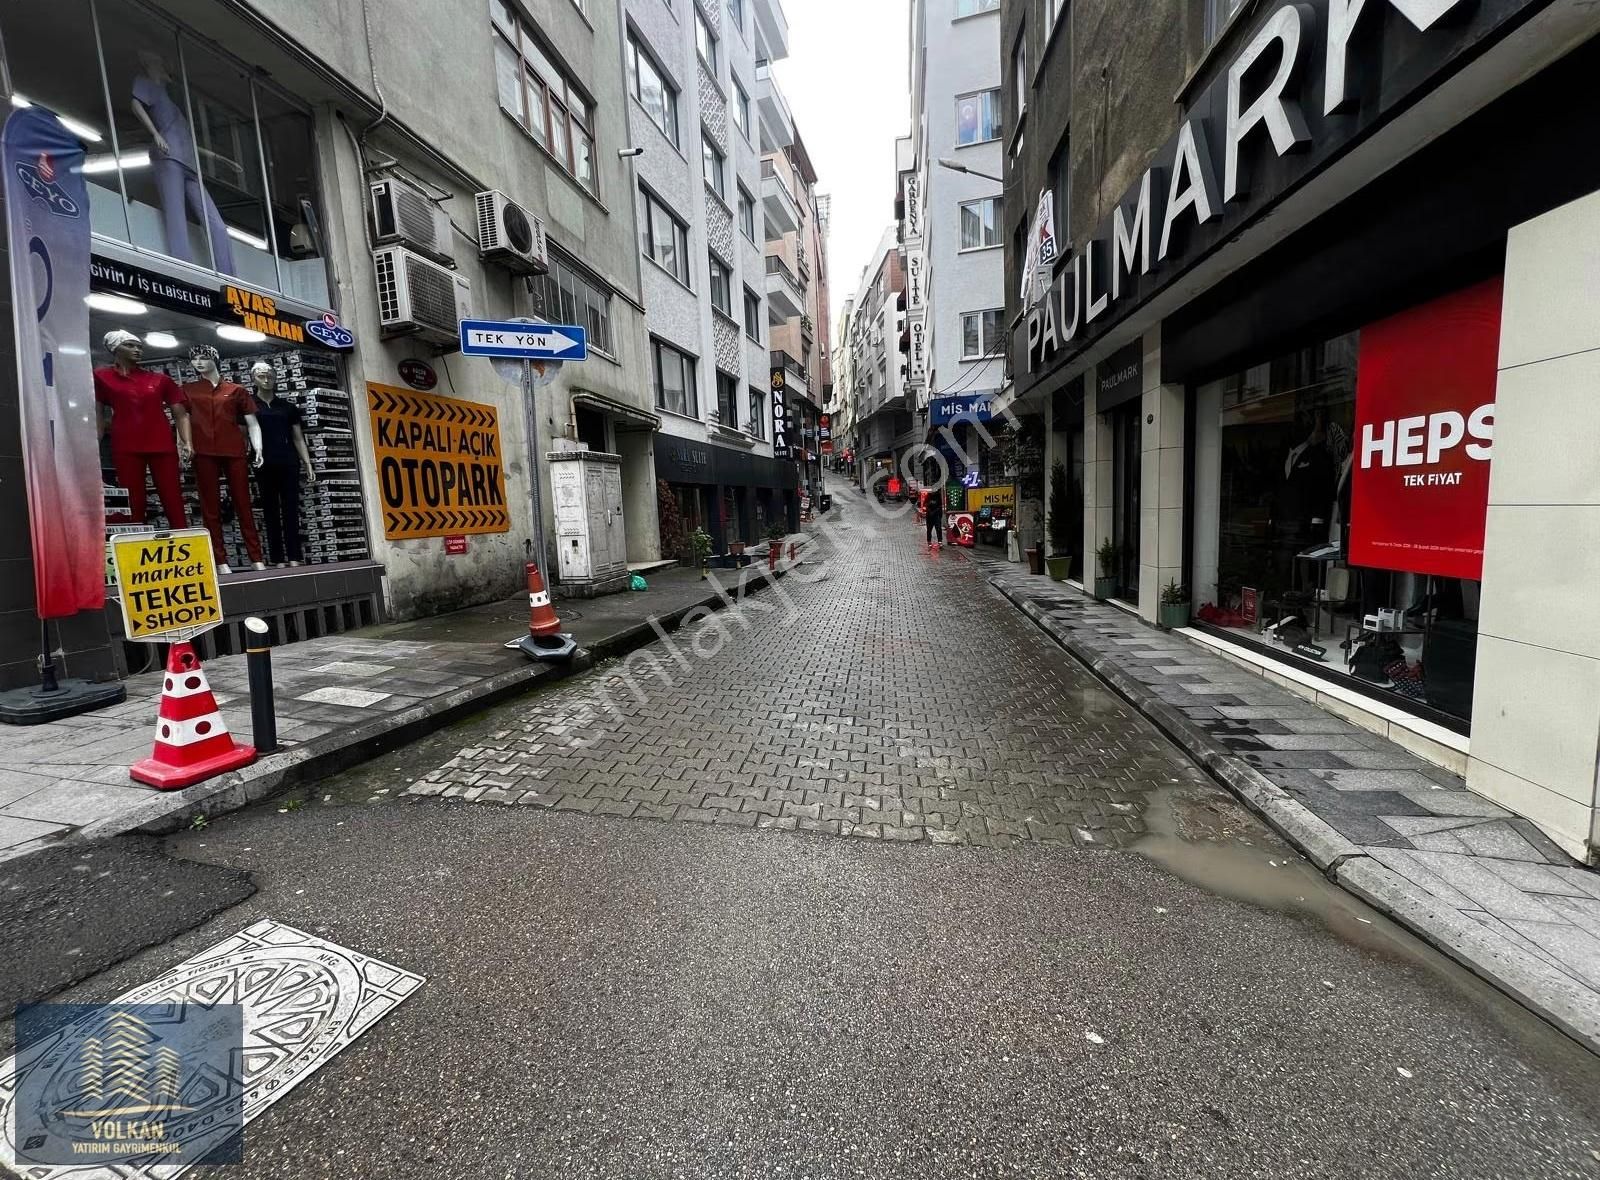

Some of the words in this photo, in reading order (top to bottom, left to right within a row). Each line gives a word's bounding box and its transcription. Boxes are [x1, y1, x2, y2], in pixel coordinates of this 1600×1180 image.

[17, 165, 77, 215] CEYO
[90, 262, 125, 285] GİYİM
[138, 273, 151, 294] İŞ
[152, 281, 212, 309] ELBİSELERİ
[911, 257, 920, 306] SUITE
[226, 285, 277, 317] AYAS
[232, 303, 246, 316] &
[244, 311, 304, 343] HAKAN
[310, 324, 352, 345] CEYO
[475, 333, 504, 344] TEK
[515, 334, 546, 347] YÖN
[913, 323, 922, 362] OTEL
[1101, 362, 1138, 393] PAULMARK
[772, 390, 786, 448] NORA
[941, 402, 963, 416] MİS
[1360, 403, 1496, 469] HEPS
[381, 456, 503, 509] OTOPARK
[1403, 473, 1425, 487] TEK
[140, 541, 191, 566] MİS
[131, 562, 204, 585] market
[129, 582, 213, 612] TEKEL
[145, 606, 205, 629] SHOP
